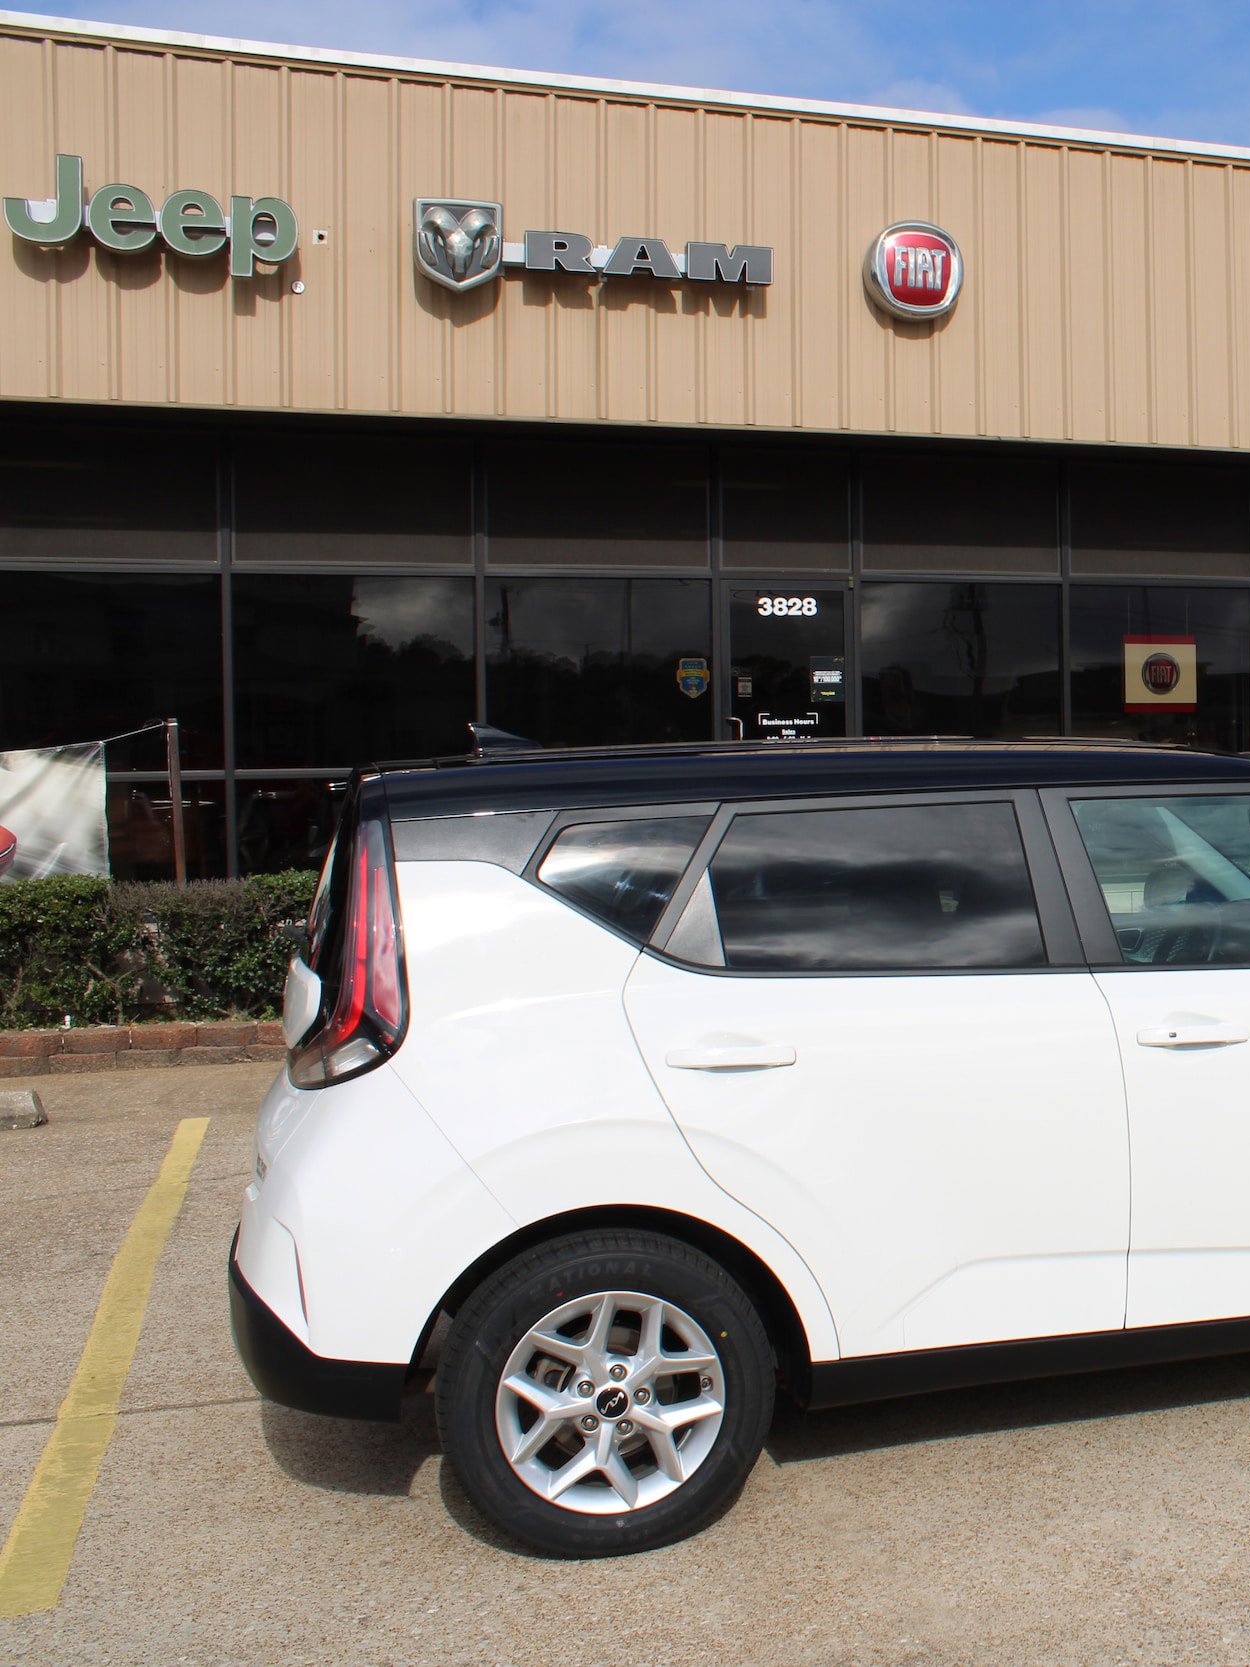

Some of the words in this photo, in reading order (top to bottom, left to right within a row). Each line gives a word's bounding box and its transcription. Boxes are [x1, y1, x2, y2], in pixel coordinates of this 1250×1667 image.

[3, 154, 299, 277] Jeep
[525, 230, 774, 285] RAM
[894, 245, 946, 291] FIAT
[757, 597, 818, 616] 3828
[1151, 666, 1172, 683] FIAT
